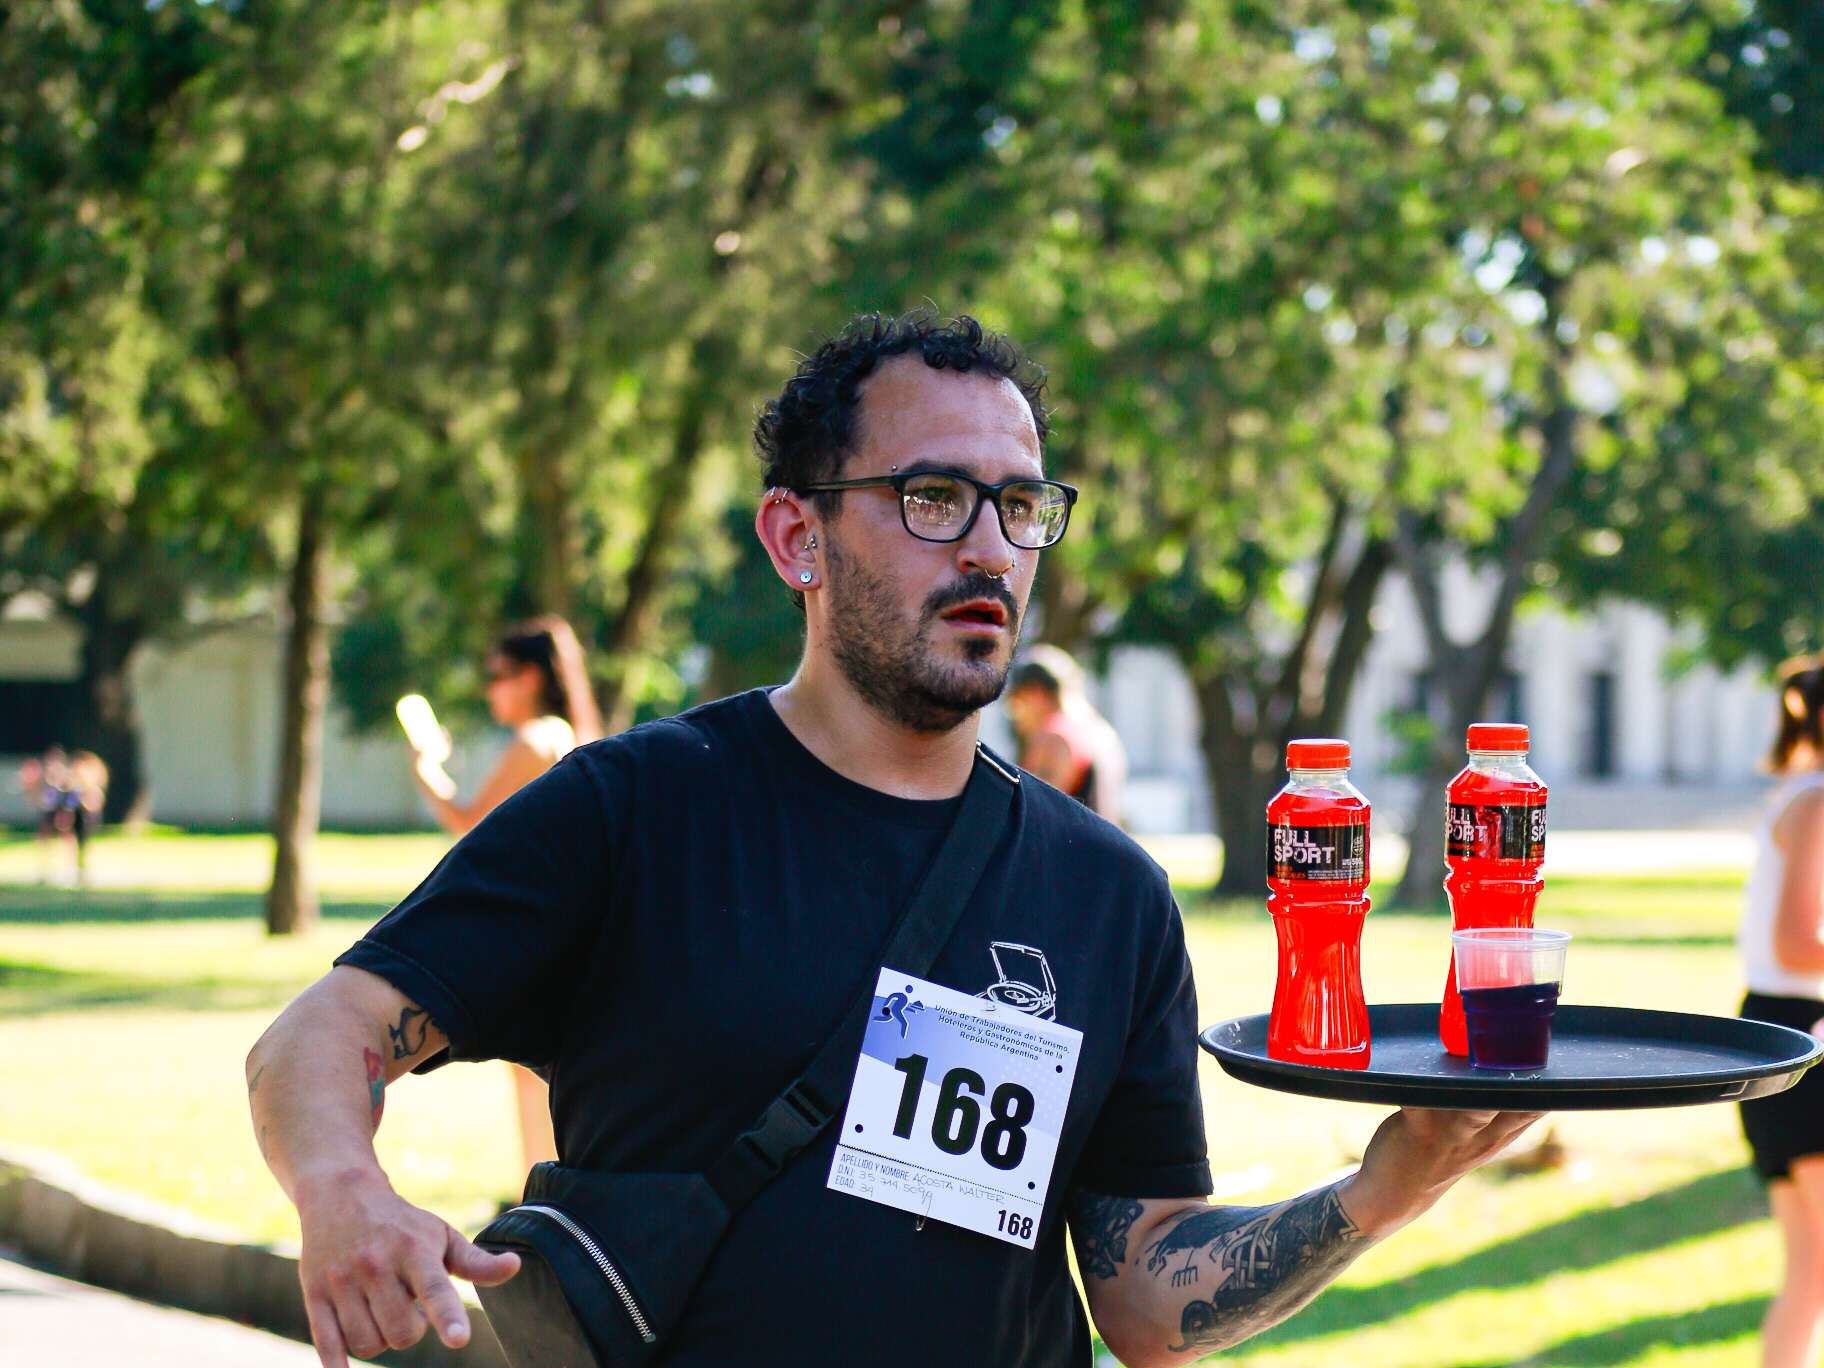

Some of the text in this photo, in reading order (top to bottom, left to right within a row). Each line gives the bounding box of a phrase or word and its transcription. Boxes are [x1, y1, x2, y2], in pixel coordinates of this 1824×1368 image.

[1446, 807, 1470, 825] ULL
[1274, 828, 1316, 848] FULL
[1446, 824, 1488, 842] PORT
[1274, 845, 1335, 864] SPORT
[935, 1004, 1070, 1054] Unión de Trabajadores del Turismo,
[938, 1015, 976, 1033] Hoteleros
[985, 1029, 1043, 1053] Gastronómicos
[1044, 1048, 1054, 1057] de
[1056, 1052, 1063, 1060] la
[960, 1030, 1039, 1061] República Argentina
[893, 1053, 1035, 1170] 168
[840, 1153, 874, 1171] APELLIDO
[875, 1162, 880, 1172] Y
[859, 1170, 876, 1182] 35
[913, 1173, 1005, 1205] ACOSTA WALTER
[998, 1209, 1034, 1240] 168
